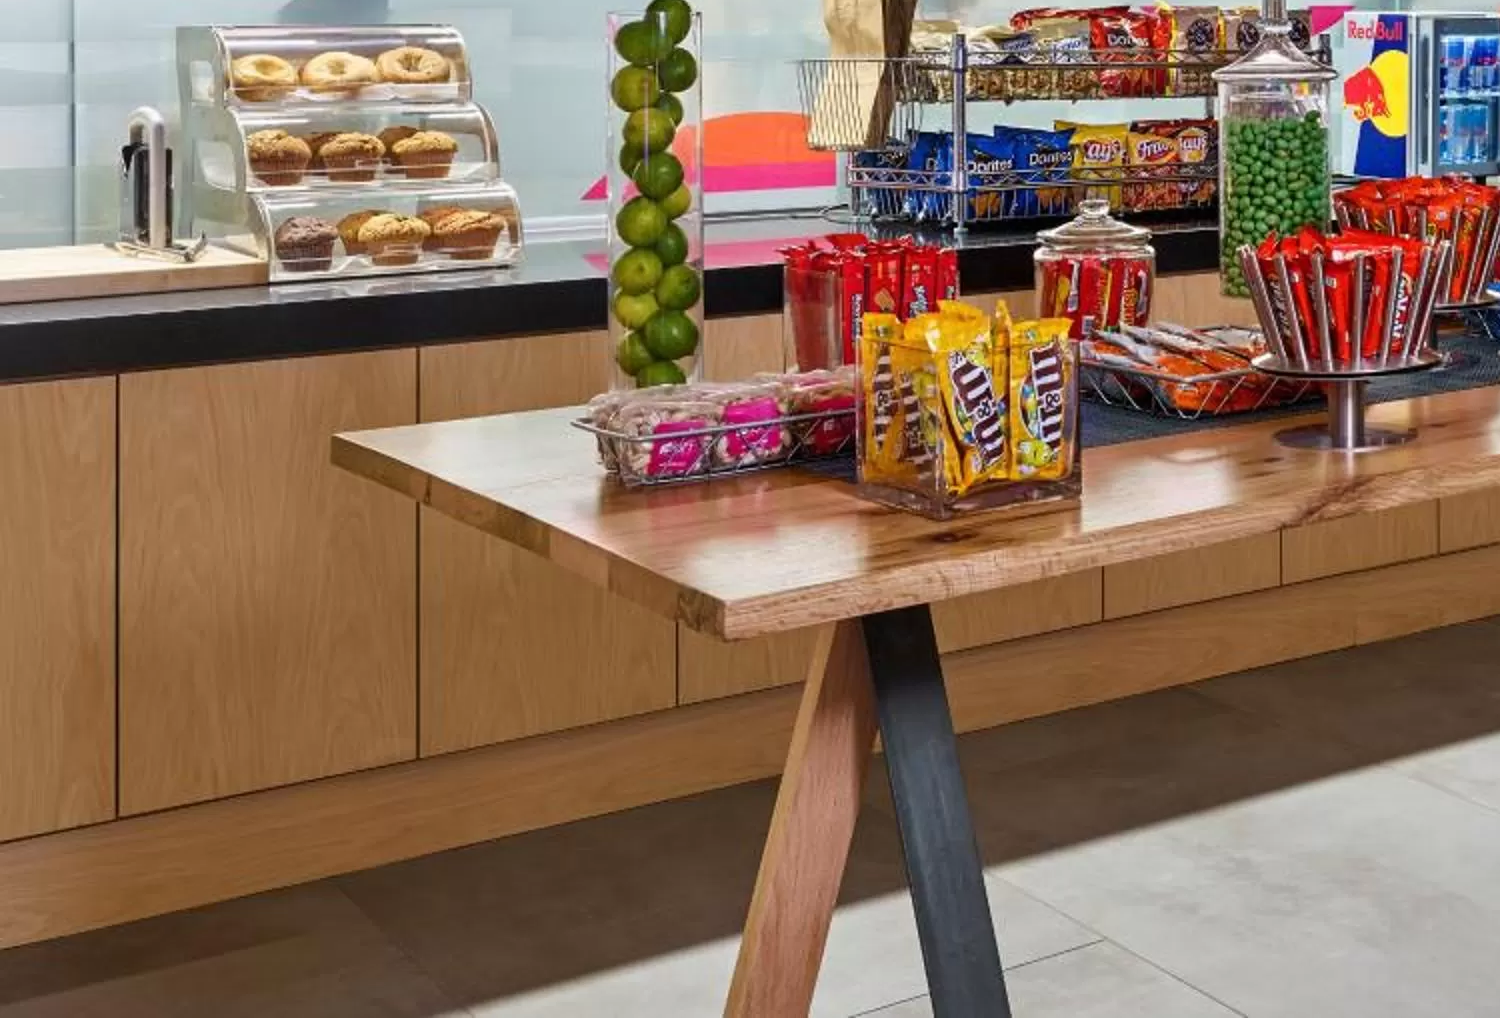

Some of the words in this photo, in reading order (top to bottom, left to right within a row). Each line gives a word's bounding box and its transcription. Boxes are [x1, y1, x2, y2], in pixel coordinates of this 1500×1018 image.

[1348, 20, 1374, 39] Red
[1375, 21, 1403, 40] Bull
[1029, 151, 1072, 167] Doritos
